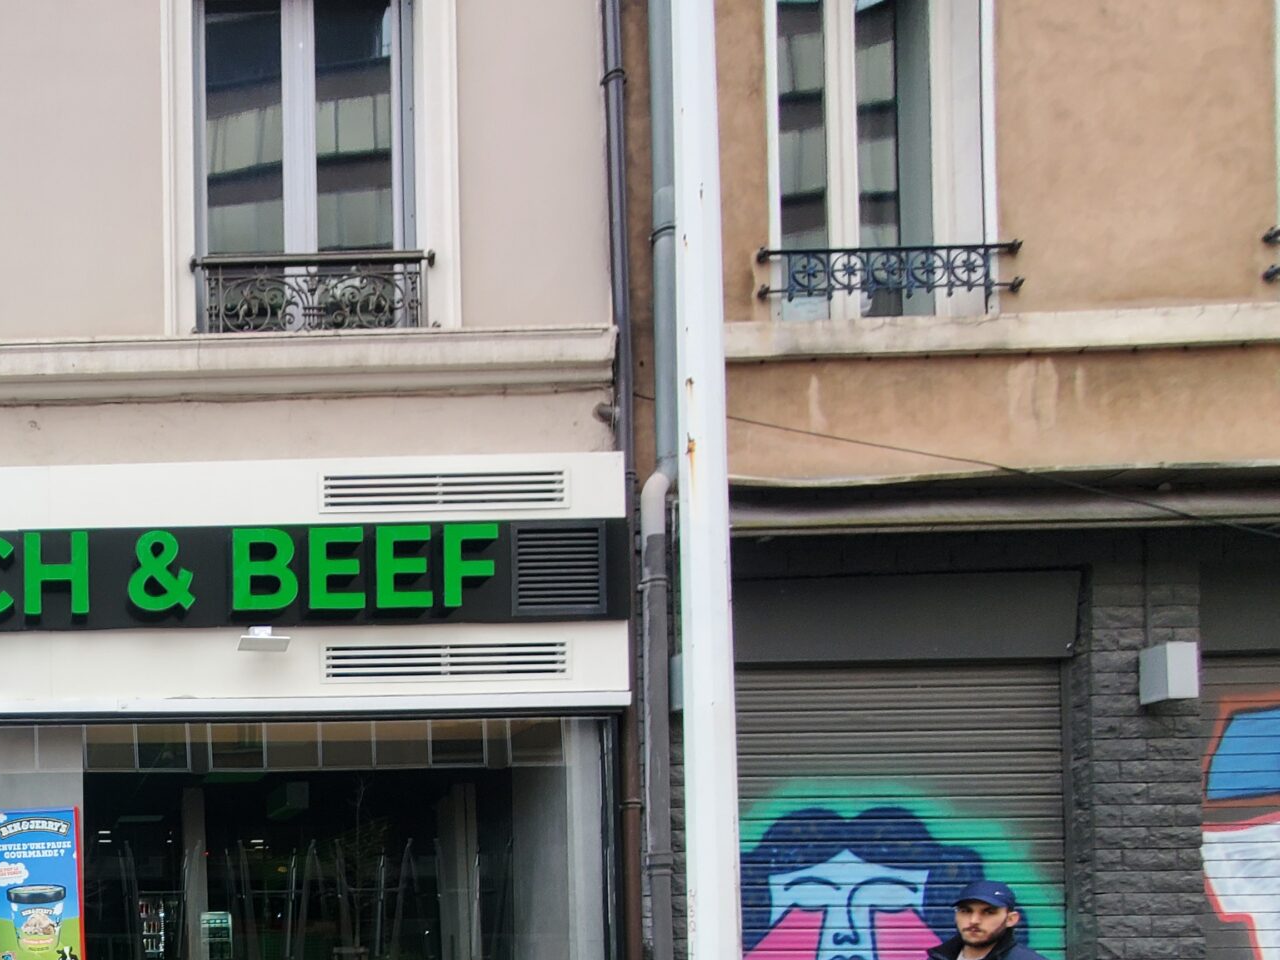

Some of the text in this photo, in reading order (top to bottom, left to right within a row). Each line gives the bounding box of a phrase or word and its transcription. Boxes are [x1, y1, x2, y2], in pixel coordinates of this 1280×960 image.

[127, 530, 195, 611] &
[232, 523, 499, 610] BEEF
[0, 822, 21, 837] BEN
[29, 820, 68, 834] JERRY'S
[22, 842, 46, 851] D'UNE
[46, 841, 72, 849] PAUSE
[3, 850, 59, 859] GOURMANDE
